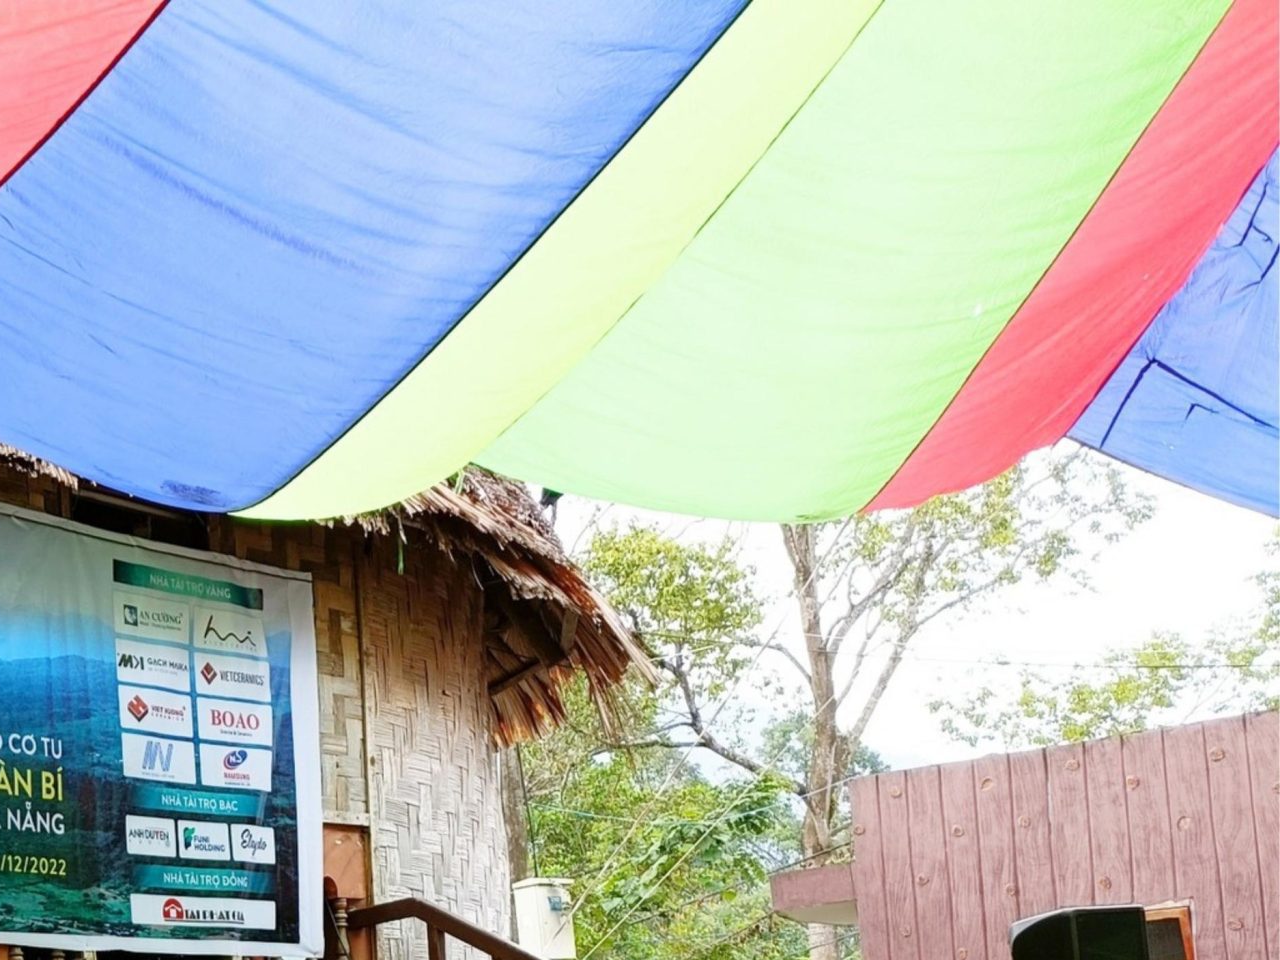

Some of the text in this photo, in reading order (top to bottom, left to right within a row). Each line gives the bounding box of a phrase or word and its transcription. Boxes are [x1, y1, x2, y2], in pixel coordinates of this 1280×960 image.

[210, 708, 260, 731] BOAO
[8, 733, 37, 756] CƠ
[41, 766, 63, 801] BÍ
[161, 793, 182, 807] NHÀ
[183, 794, 197, 808] TÀI
[7, 800, 66, 836] NẴNG
[163, 871, 184, 883] NHÀ
[185, 871, 199, 886] TÀI
